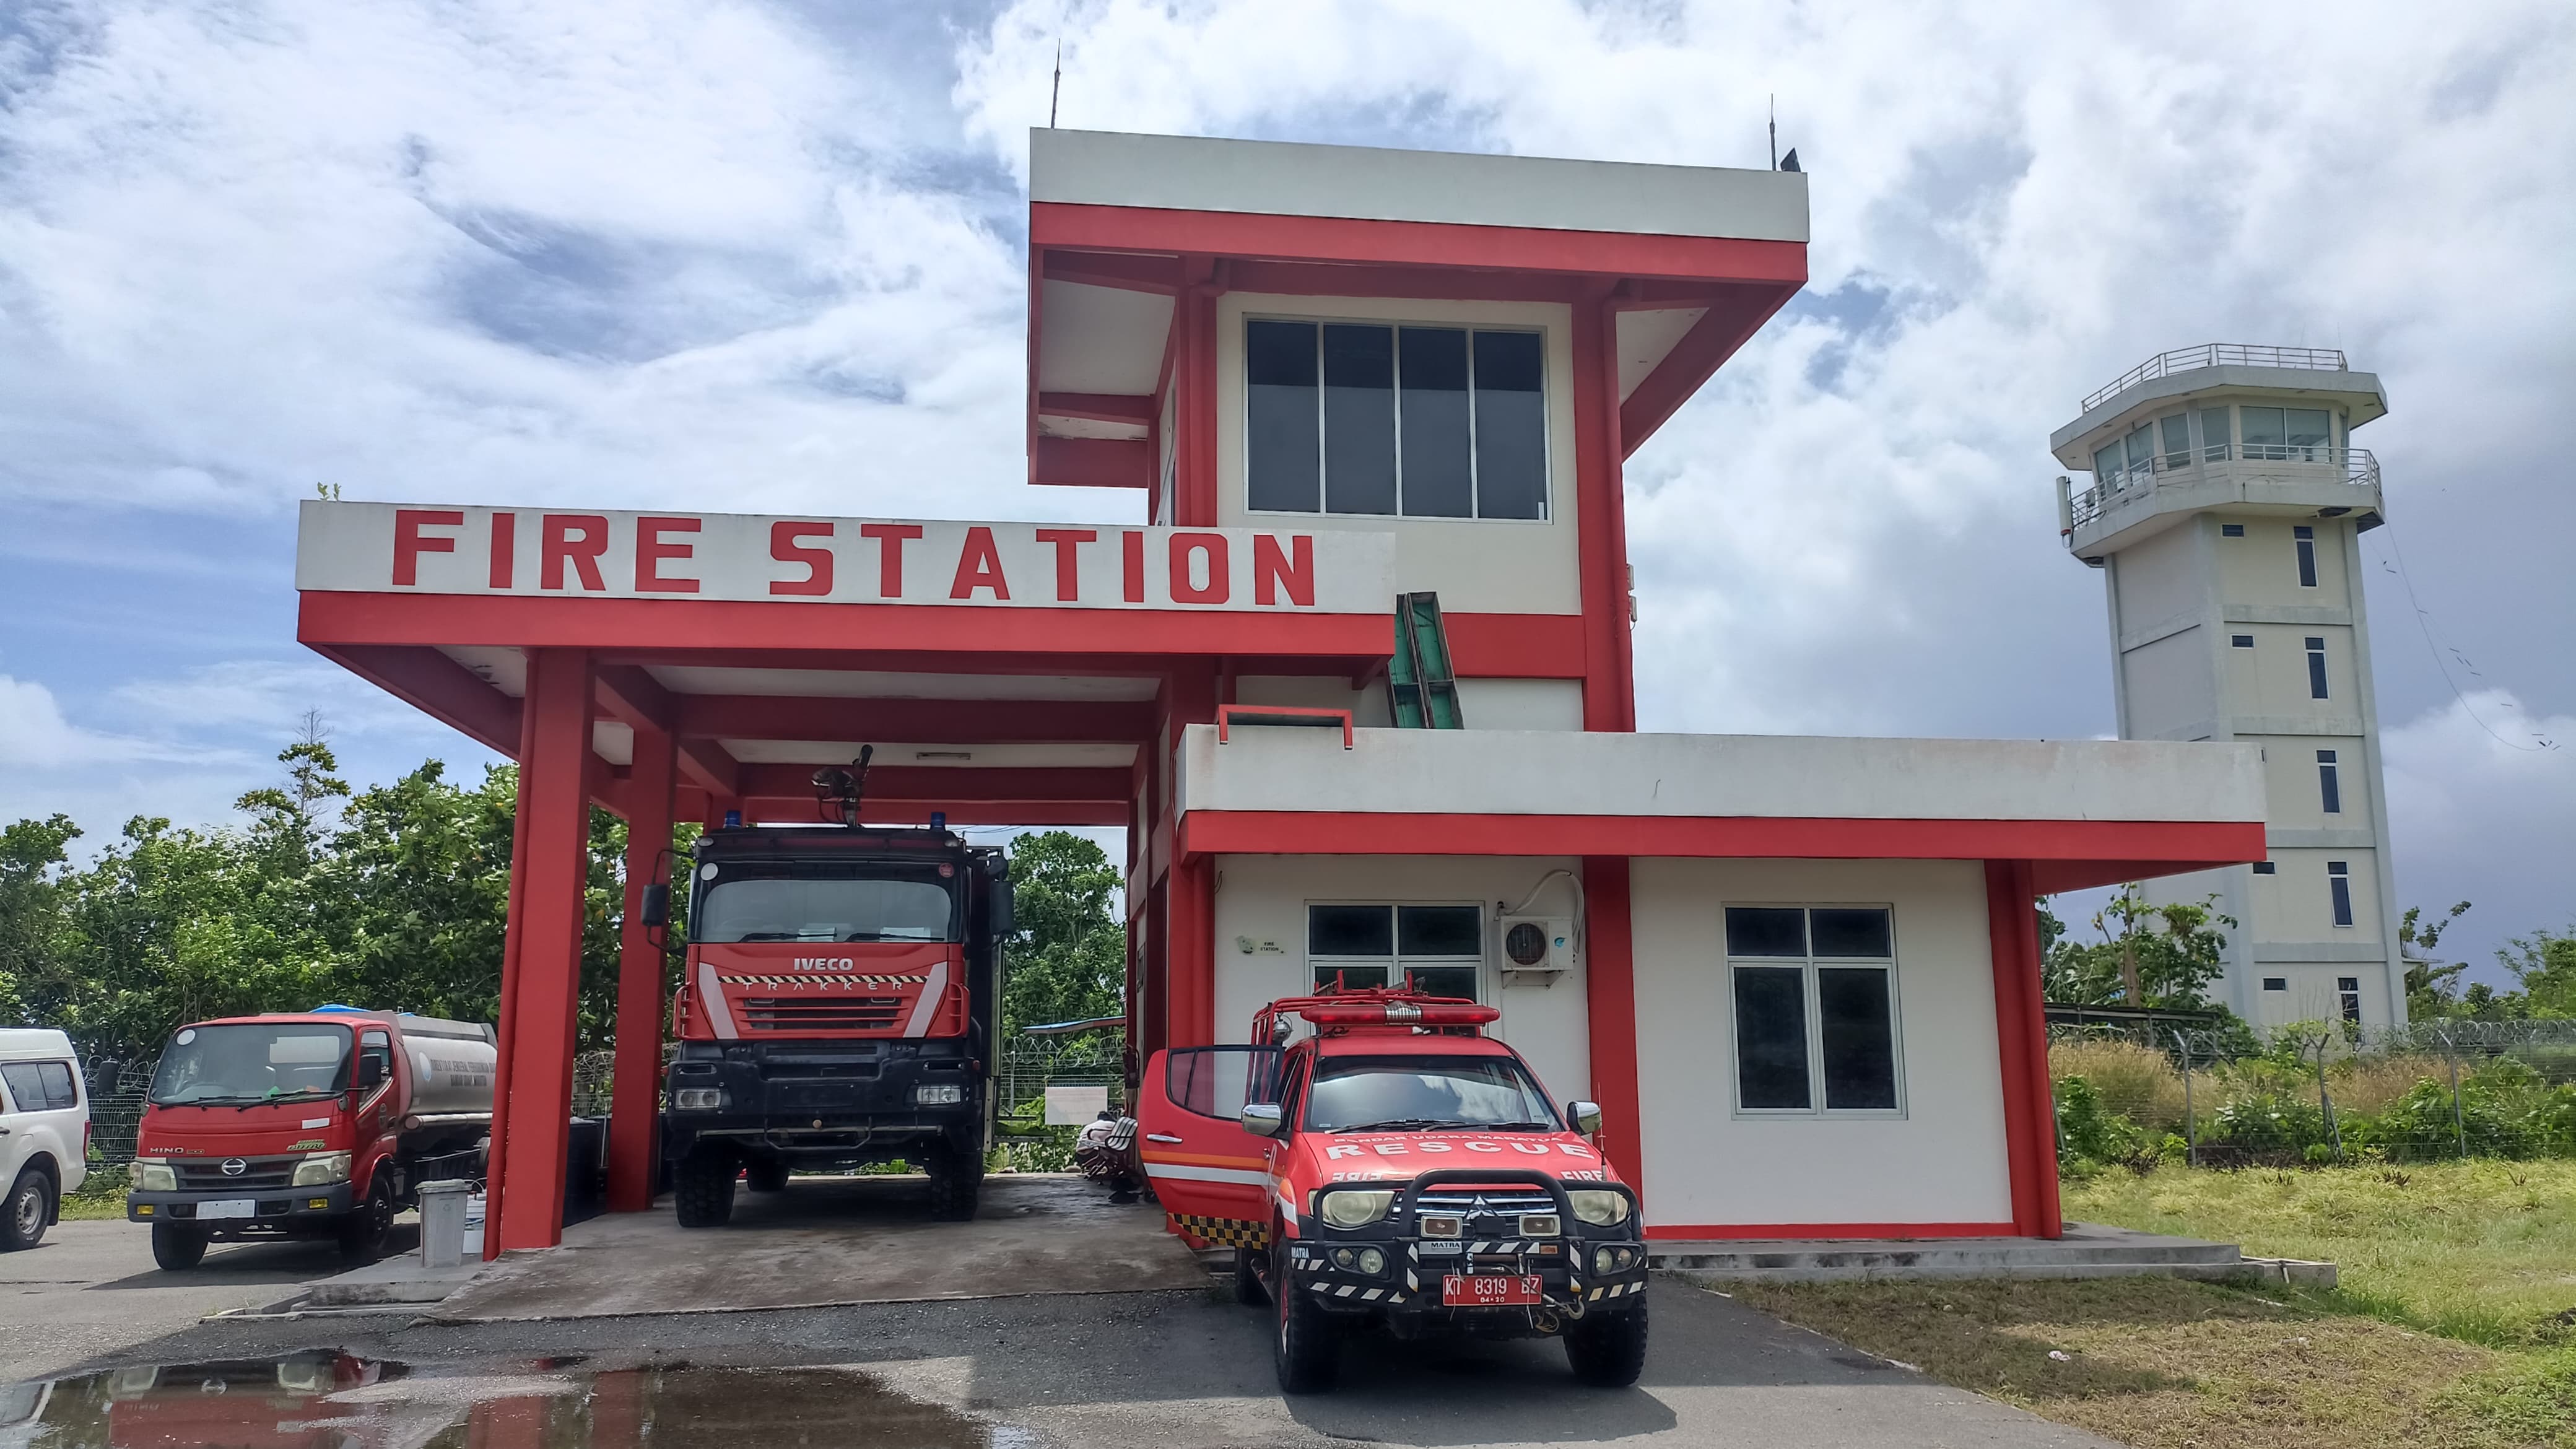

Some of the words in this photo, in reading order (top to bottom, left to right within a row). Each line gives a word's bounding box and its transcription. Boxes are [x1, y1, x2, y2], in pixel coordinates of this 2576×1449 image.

[392, 510, 702, 593] FIRE
[770, 521, 1315, 606] STATION
[794, 958, 853, 970] IVECO
[743, 982, 902, 991] TRAKKER
[1325, 1141, 1595, 1160] RESCUE
[1291, 1247, 1310, 1259] MATRA
[1445, 1277, 1461, 1295] KT
[1474, 1277, 1507, 1295] 8319
